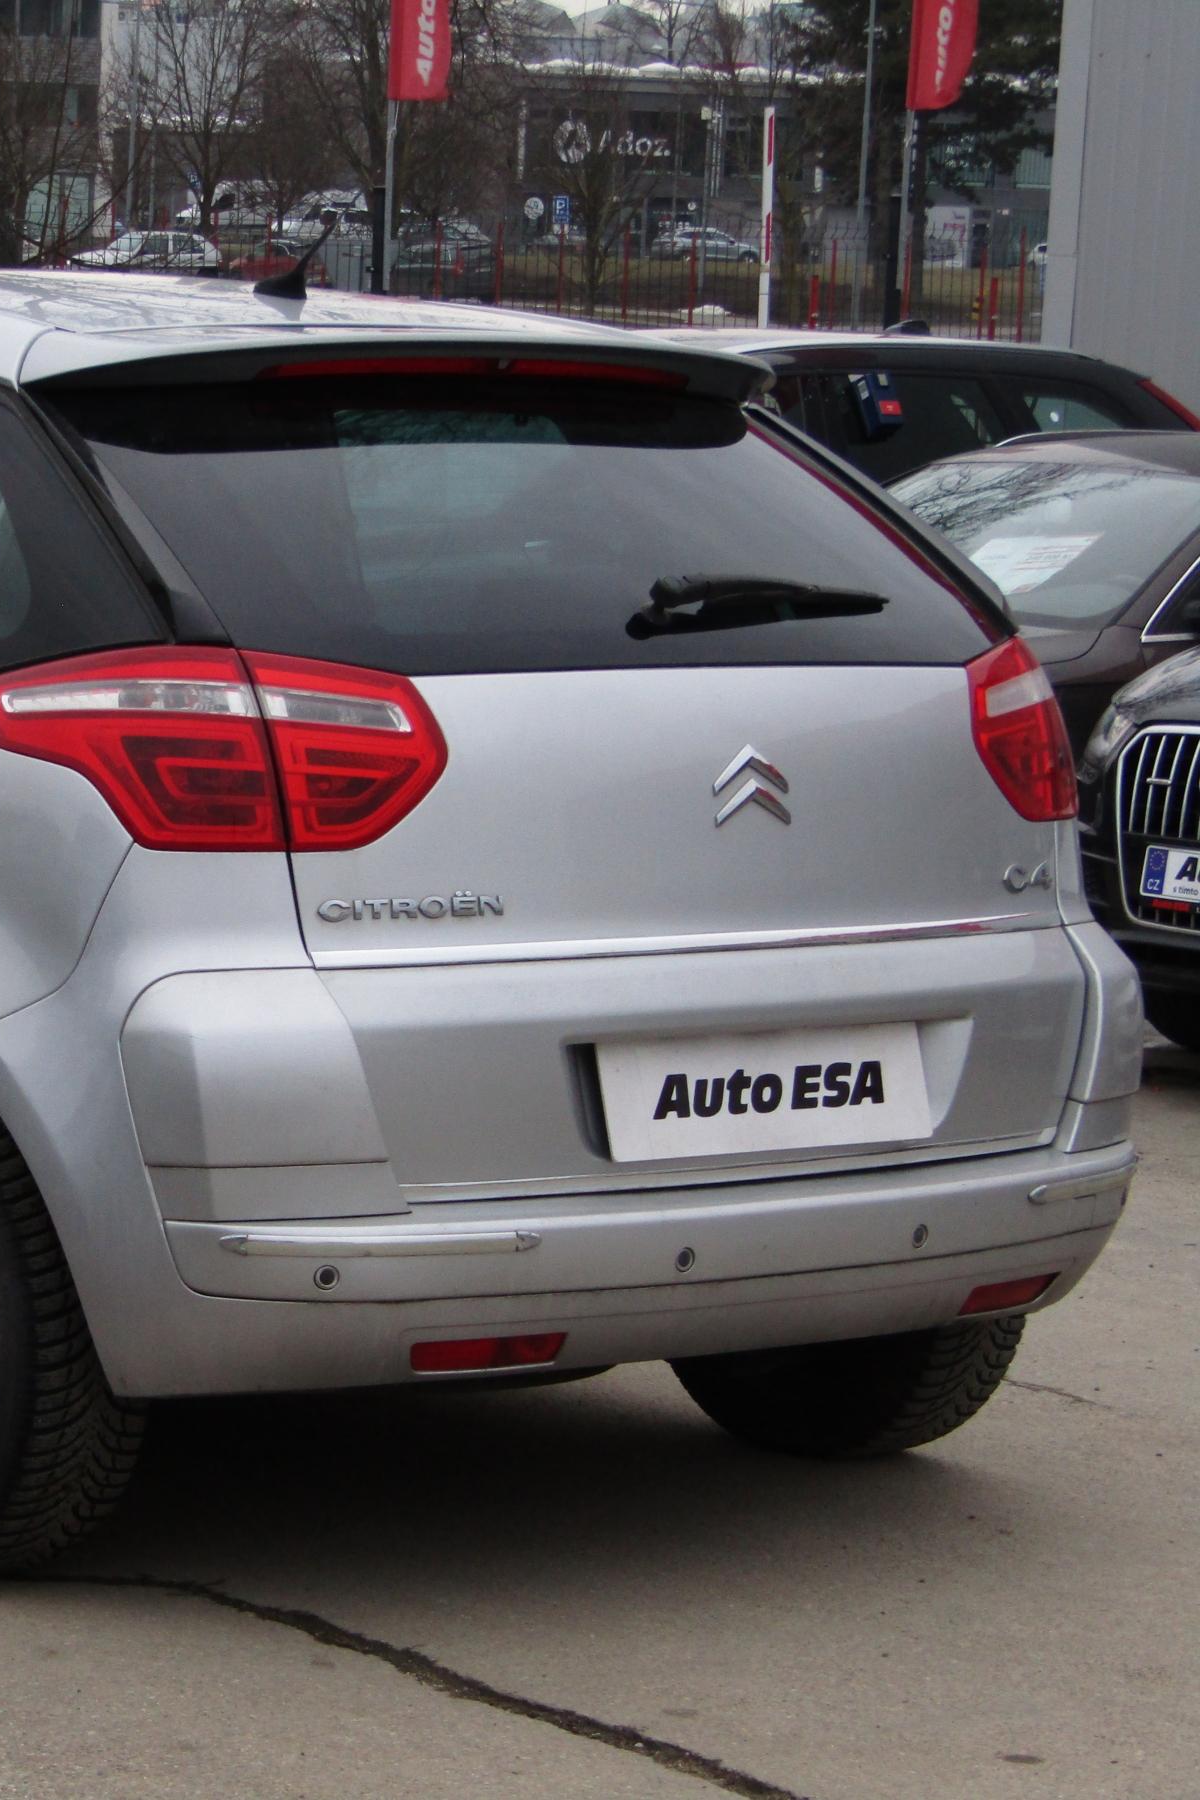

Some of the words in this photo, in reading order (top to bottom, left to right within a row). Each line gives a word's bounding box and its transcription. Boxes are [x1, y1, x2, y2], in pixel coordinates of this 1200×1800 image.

[1175, 856, 1200, 883] A
[1147, 879, 1160, 891] CZ
[317, 890, 504, 923] CITROËN
[653, 1069, 783, 1120] Auto
[791, 1060, 885, 1110] ESA
